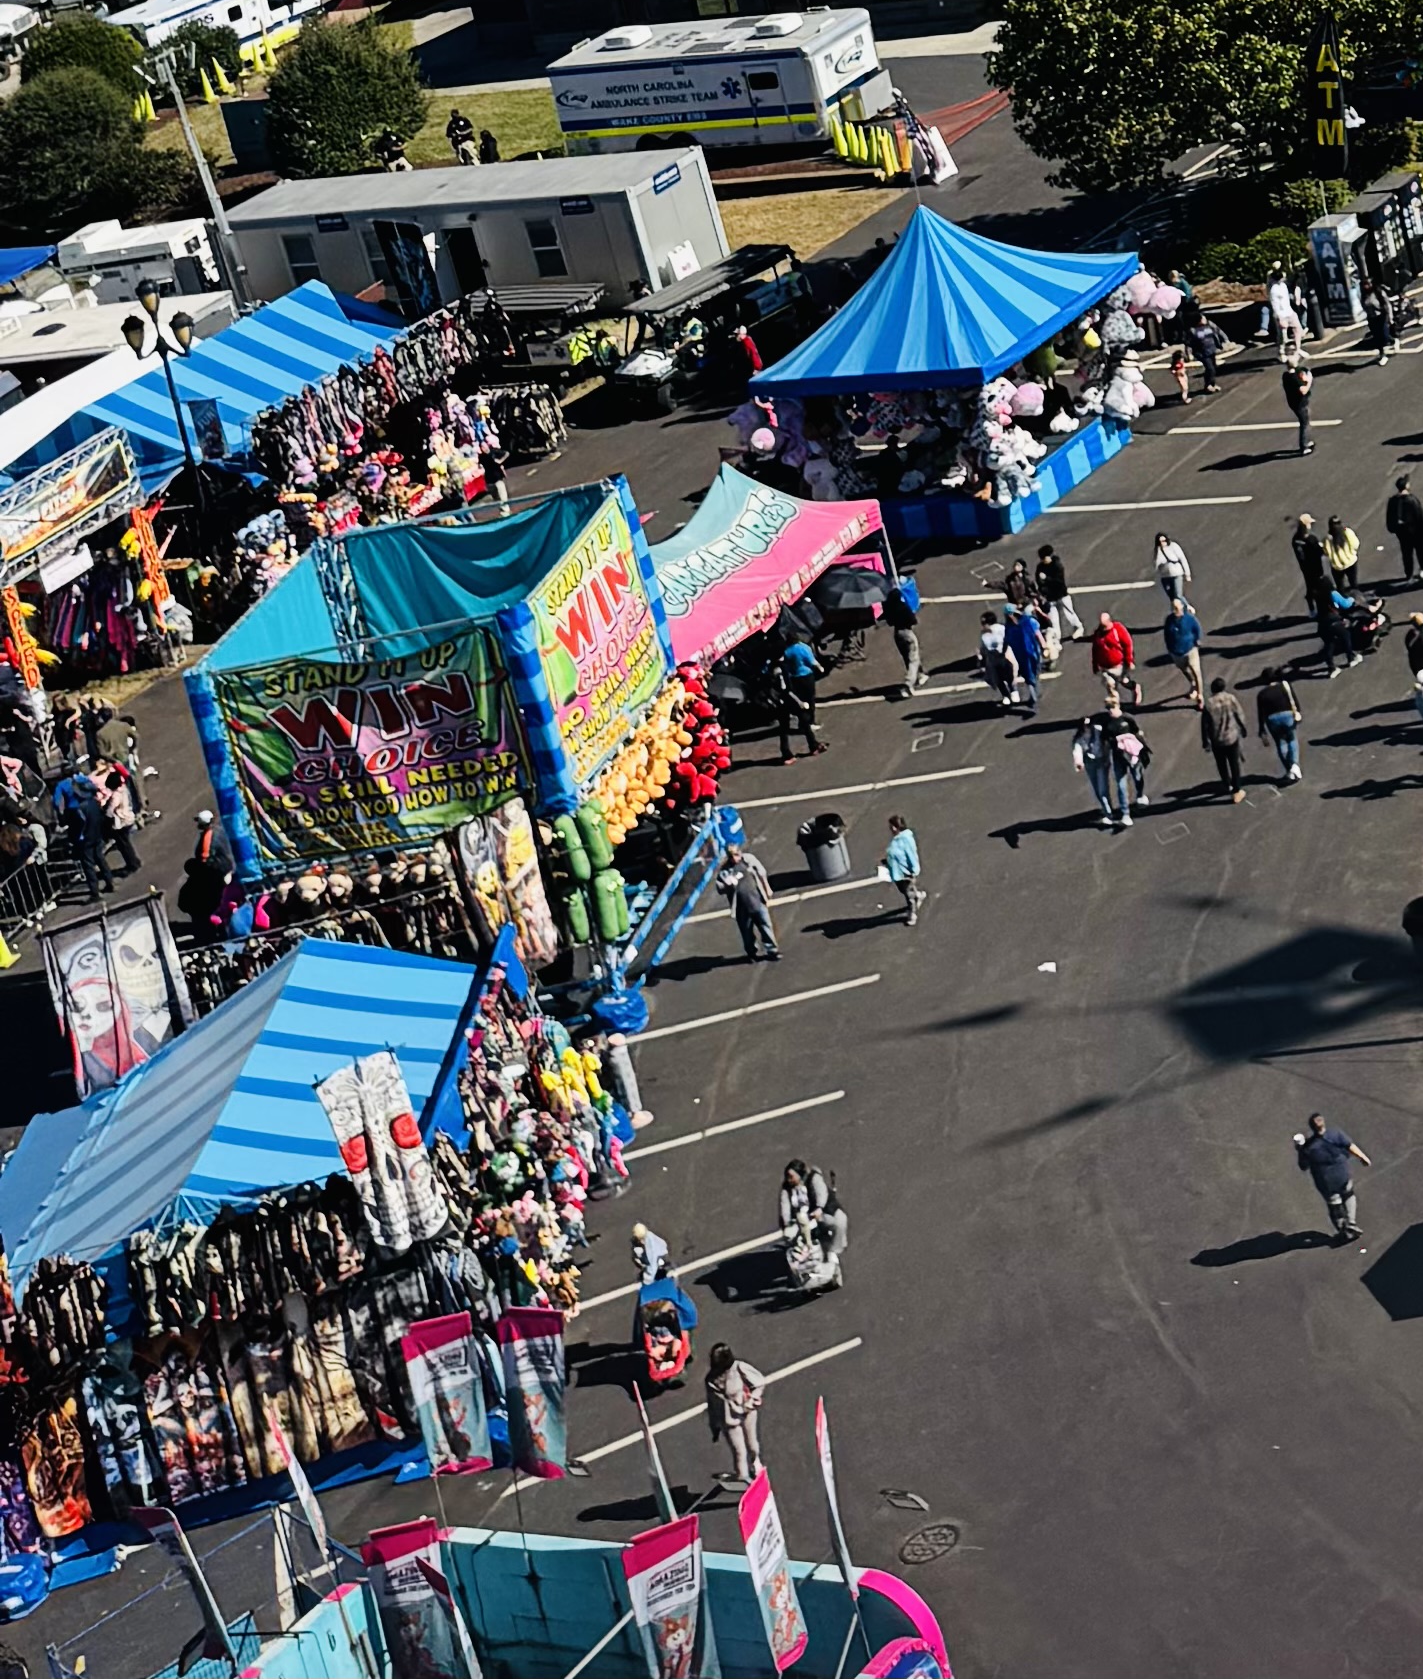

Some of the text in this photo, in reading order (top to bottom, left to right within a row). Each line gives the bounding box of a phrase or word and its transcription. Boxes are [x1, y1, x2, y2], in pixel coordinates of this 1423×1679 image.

[590, 90, 719, 110] AMBULANCE STRIKE TEAM
[605, 78, 695, 96] NORTH CAROLINA
[1316, 44, 1345, 146] ATM
[641, 113, 684, 126] COUNTY
[1321, 242, 1347, 299] ATM
[547, 518, 614, 615] STAND IT UP
[655, 488, 798, 616] CARICATURES
[554, 551, 631, 662] WIN
[265, 641, 457, 697] STAND IT UP
[575, 593, 648, 696] CHOICE
[267, 670, 475, 752] WIN
[560, 705, 586, 738] NO
[590, 666, 625, 711] SKILL
[262, 751, 519, 813] NO SKILL NEEDED
[293, 721, 485, 783] CHOICE
[302, 805, 360, 829] SHOW
[363, 797, 399, 818] YOU
[403, 783, 450, 811] HOW
[451, 780, 476, 800] TO
[485, 771, 518, 795] WIN
